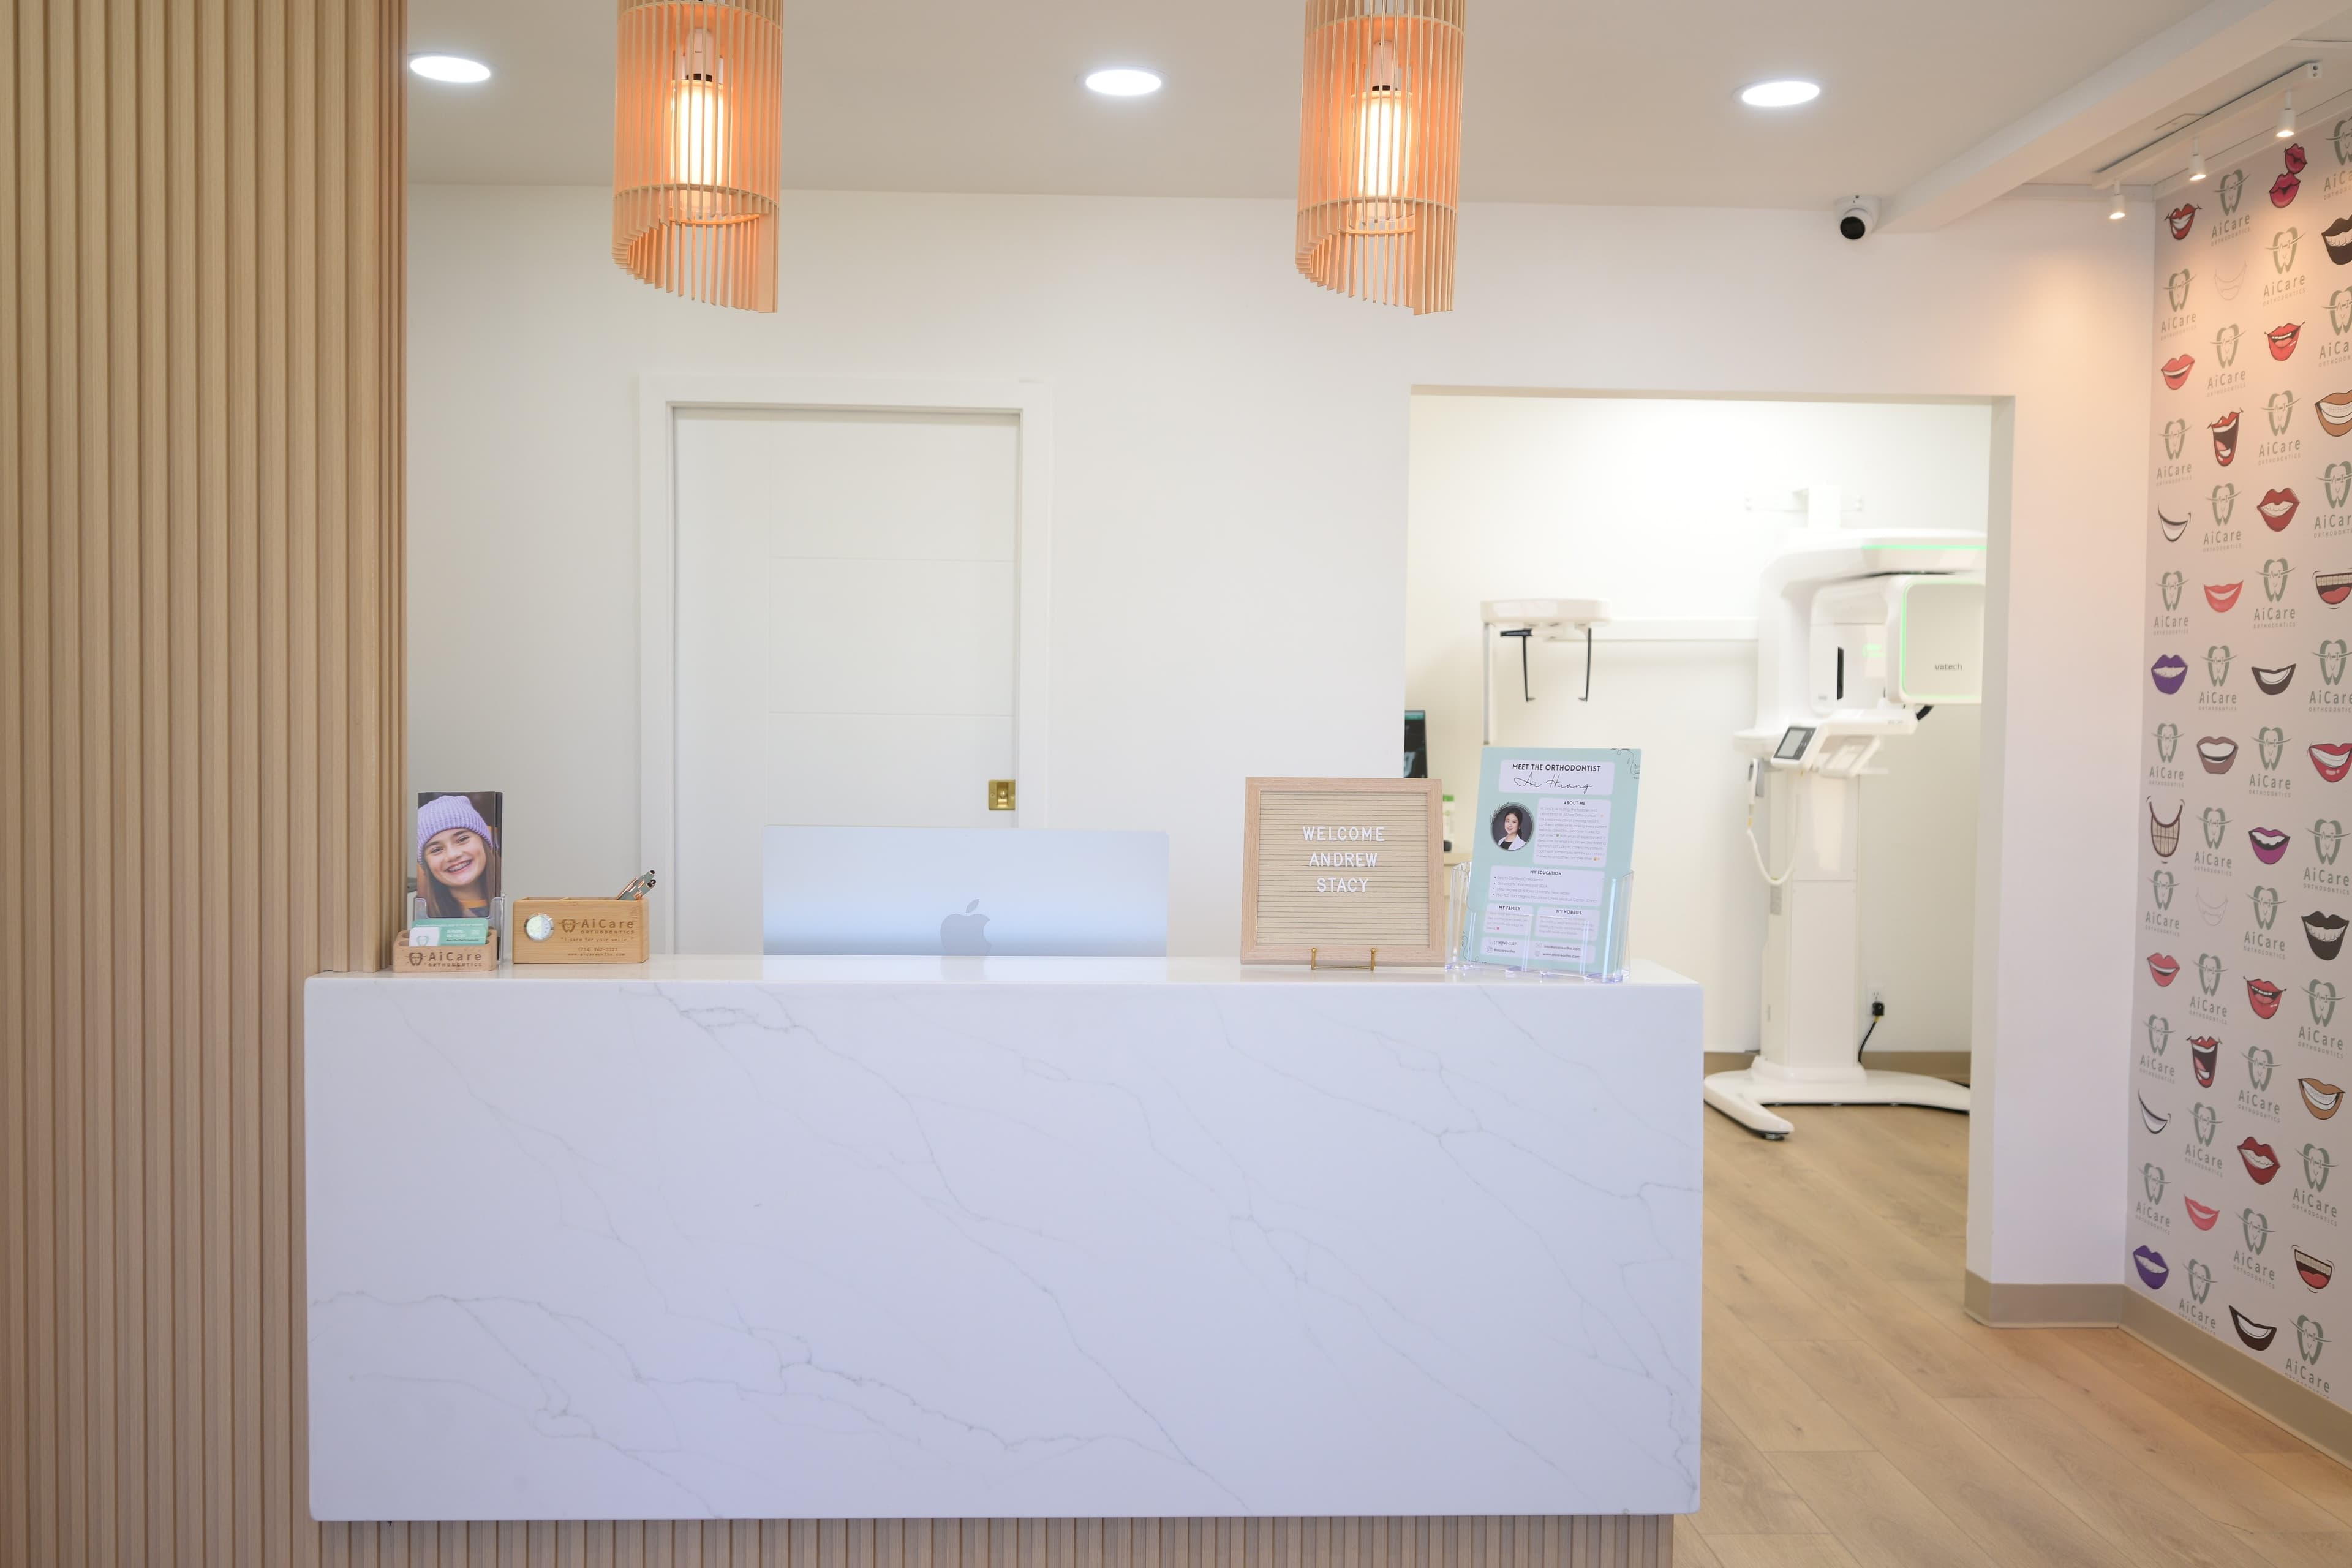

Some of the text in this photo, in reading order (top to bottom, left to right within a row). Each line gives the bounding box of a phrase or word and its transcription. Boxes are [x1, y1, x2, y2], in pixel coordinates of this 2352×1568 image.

[2324, 170, 2352, 191] AiCa
[2212, 214, 2250, 239] AiCare
[2264, 275, 2305, 298] AiCare
[2162, 313, 2196, 333] AiCare
[2320, 341, 2349, 359] AiCa
[2318, 355, 2352, 368] ORTHODON
[2208, 370, 2245, 390] AiCare
[2259, 439, 2300, 458] AiCare
[2157, 463, 2191, 479] AiCare
[2314, 514, 2352, 530] AiCar
[2204, 530, 2241, 545] AiCare
[2313, 529, 2352, 538] ORTHODONT
[2154, 616, 2188, 628] AiCare
[2254, 608, 2295, 620] AiCare
[2199, 692, 2236, 704] AiCare
[2309, 690, 2352, 704] AiCare
[2149, 766, 2184, 780] AiCare
[2250, 774, 2291, 789] AiCare
[1513, 772, 1593, 794] Ai Huang
[1303, 826, 1385, 842] WELCOME
[1309, 851, 1378, 867] ANDREW
[2195, 851, 2232, 869] AiCare
[1317, 878, 1368, 893] STACY
[2304, 867, 2350, 886] AiCare
[581, 919, 634, 929] AiCare
[2146, 912, 2180, 929] AiCare
[2244, 931, 2286, 951] AiCare
[429, 952, 481, 961] AiCare
[2190, 996, 2227, 1017] AiCare
[2298, 1026, 2343, 1050] AiCare
[2140, 1055, 2175, 1076] AiCare
[2239, 1090, 2280, 1115] AiCare
[2185, 1144, 2222, 1169] AiCare
[2293, 1188, 2337, 1218] AiCare
[2136, 1202, 2170, 1227] AiCare
[2234, 1251, 2275, 1281] AiCare
[2180, 1298, 2216, 1329] AiCare
[2286, 1358, 2330, 1393] AiCare
